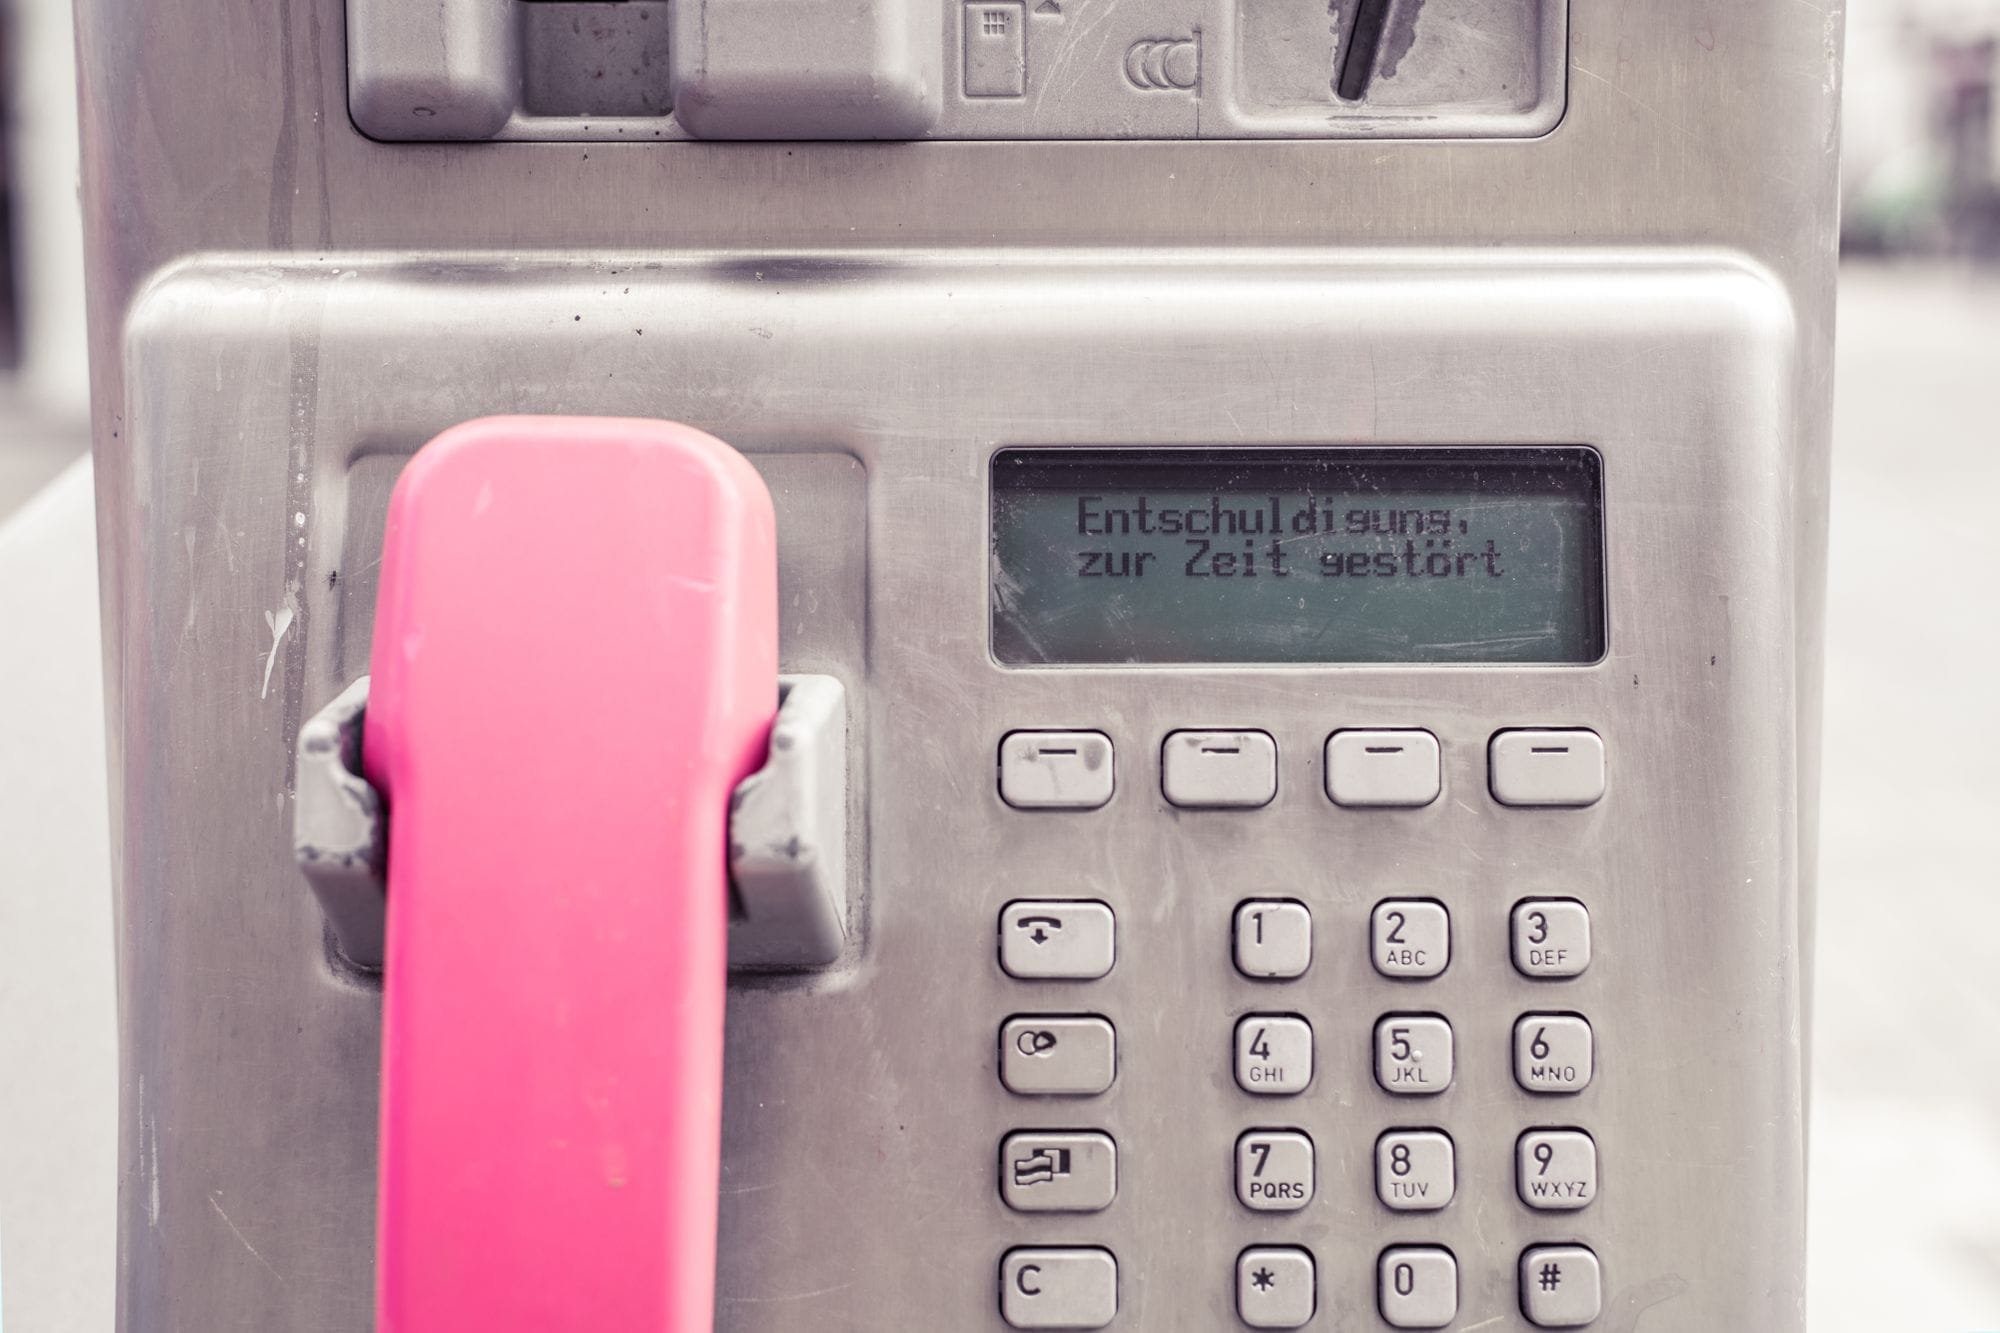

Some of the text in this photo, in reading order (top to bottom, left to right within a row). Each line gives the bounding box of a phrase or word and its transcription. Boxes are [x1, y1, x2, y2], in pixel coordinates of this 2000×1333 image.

[1077, 539, 1505, 578] zur Zeit gestört
[1251, 912, 1263, 944] 1
[1386, 912, 1405, 944] 2
[1528, 912, 1547, 944] 3
[1386, 950, 1426, 966] ABC
[1530, 950, 1567, 965] DEF
[1249, 1029, 1270, 1061] 4
[1391, 1029, 1410, 1060] 5
[1530, 1027, 1549, 1059] 6
[1250, 1067, 1284, 1082] GHI
[1391, 1068, 1428, 1083] JKL
[1530, 1067, 1575, 1081] MNO
[1250, 1144, 1270, 1177] 7
[1391, 1144, 1411, 1176] 8
[1534, 1143, 1553, 1175] 9
[1250, 1183, 1304, 1199] PQRS
[1391, 1183, 1429, 1198] TUV
[1531, 1182, 1586, 1198] WXYZ
[1016, 1265, 1041, 1296] C
[1395, 1263, 1413, 1295] 0
[1538, 1265, 1561, 1291] #
